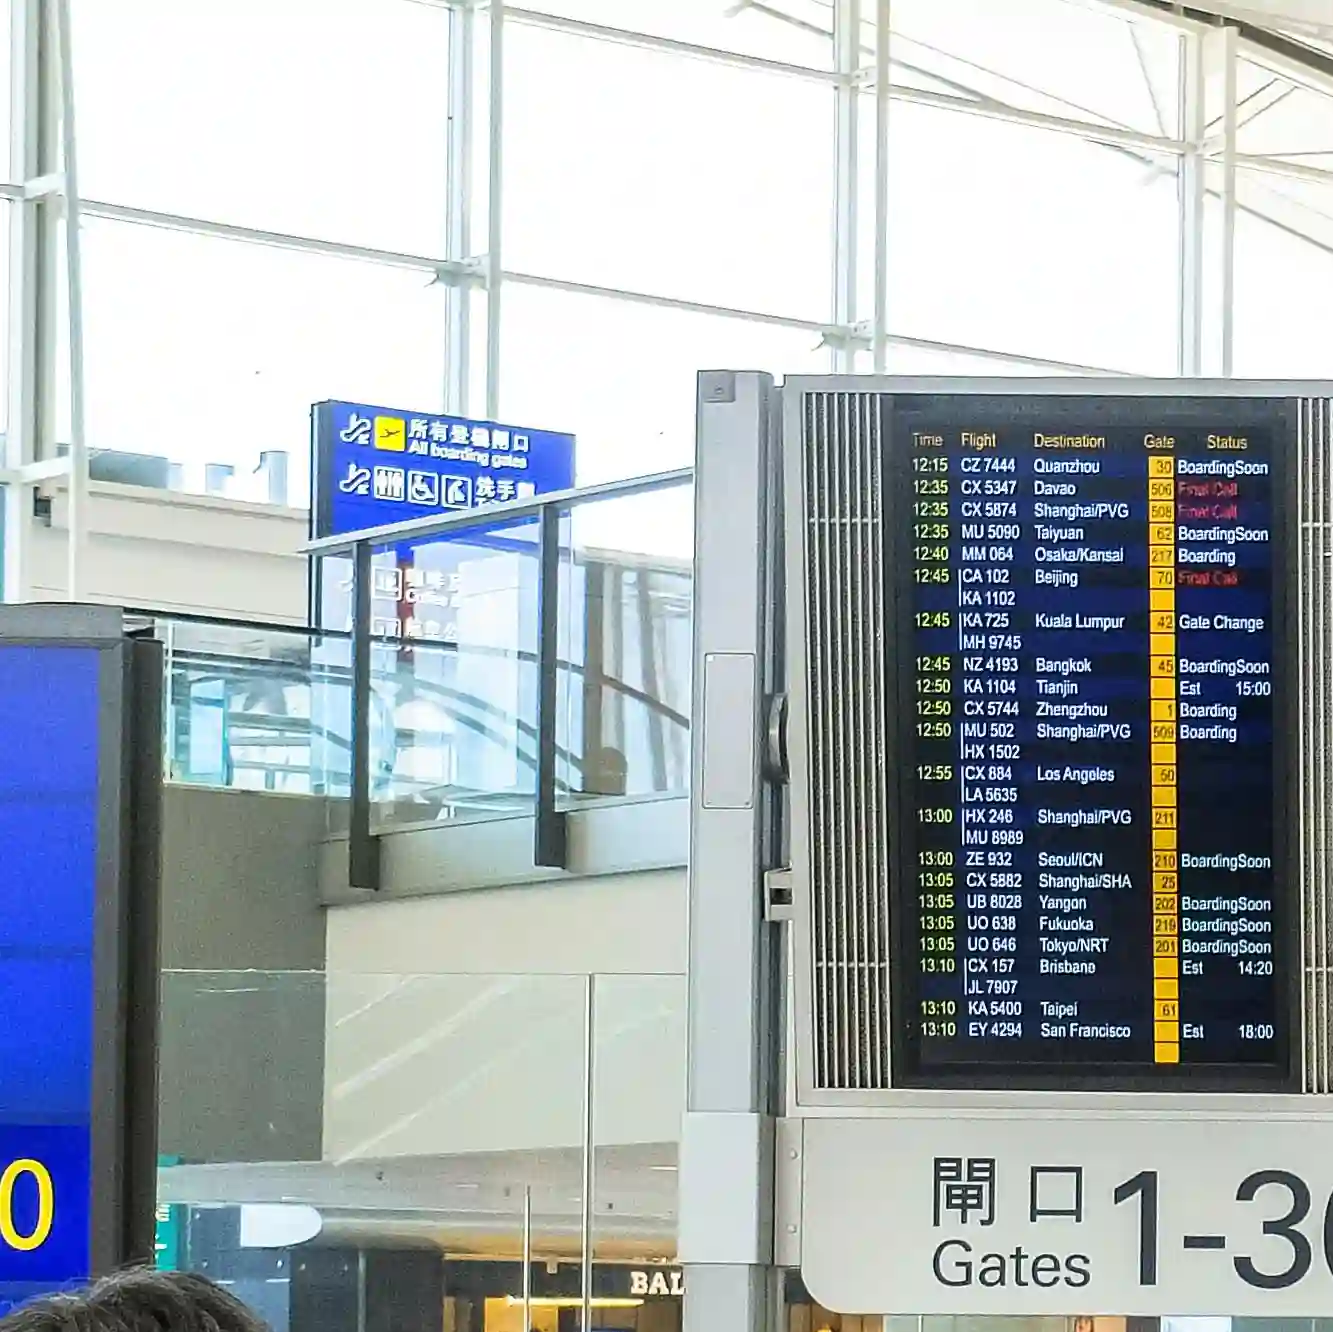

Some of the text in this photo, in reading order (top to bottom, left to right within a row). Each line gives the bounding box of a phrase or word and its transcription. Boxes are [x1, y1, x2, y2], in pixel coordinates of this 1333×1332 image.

[960, 432, 997, 450] Flight
[1033, 433, 1106, 449] Destination
[1144, 434, 1175, 450] Gate
[1206, 434, 1248, 450] Status
[912, 455, 948, 472] 12:15
[961, 456, 982, 473] CZ
[983, 456, 1016, 473] 7444
[1032, 457, 1100, 474] Quanzhou
[914, 479, 949, 494] 12:35
[961, 479, 982, 497] CX
[983, 479, 1017, 497] 5347
[1034, 479, 1076, 496] Davao
[913, 523, 949, 539] 12:35
[961, 523, 985, 539] MU
[987, 524, 1020, 540] 5090
[1034, 524, 1084, 544] Taiyuan
[915, 612, 950, 627] 12:45
[963, 612, 982, 628] KA
[984, 612, 1010, 628] 725
[1035, 613, 1073, 628] Kuala
[1075, 612, 1125, 632] Lumpur
[1179, 614, 1211, 629] Gate
[1213, 614, 1265, 633] Change
[920, 1021, 1274, 1039] 13:10 EY 4294 San Francisco Est 18:00
[932, 1157, 1083, 1227] 閘口
[932, 1239, 1091, 1288] Gates
